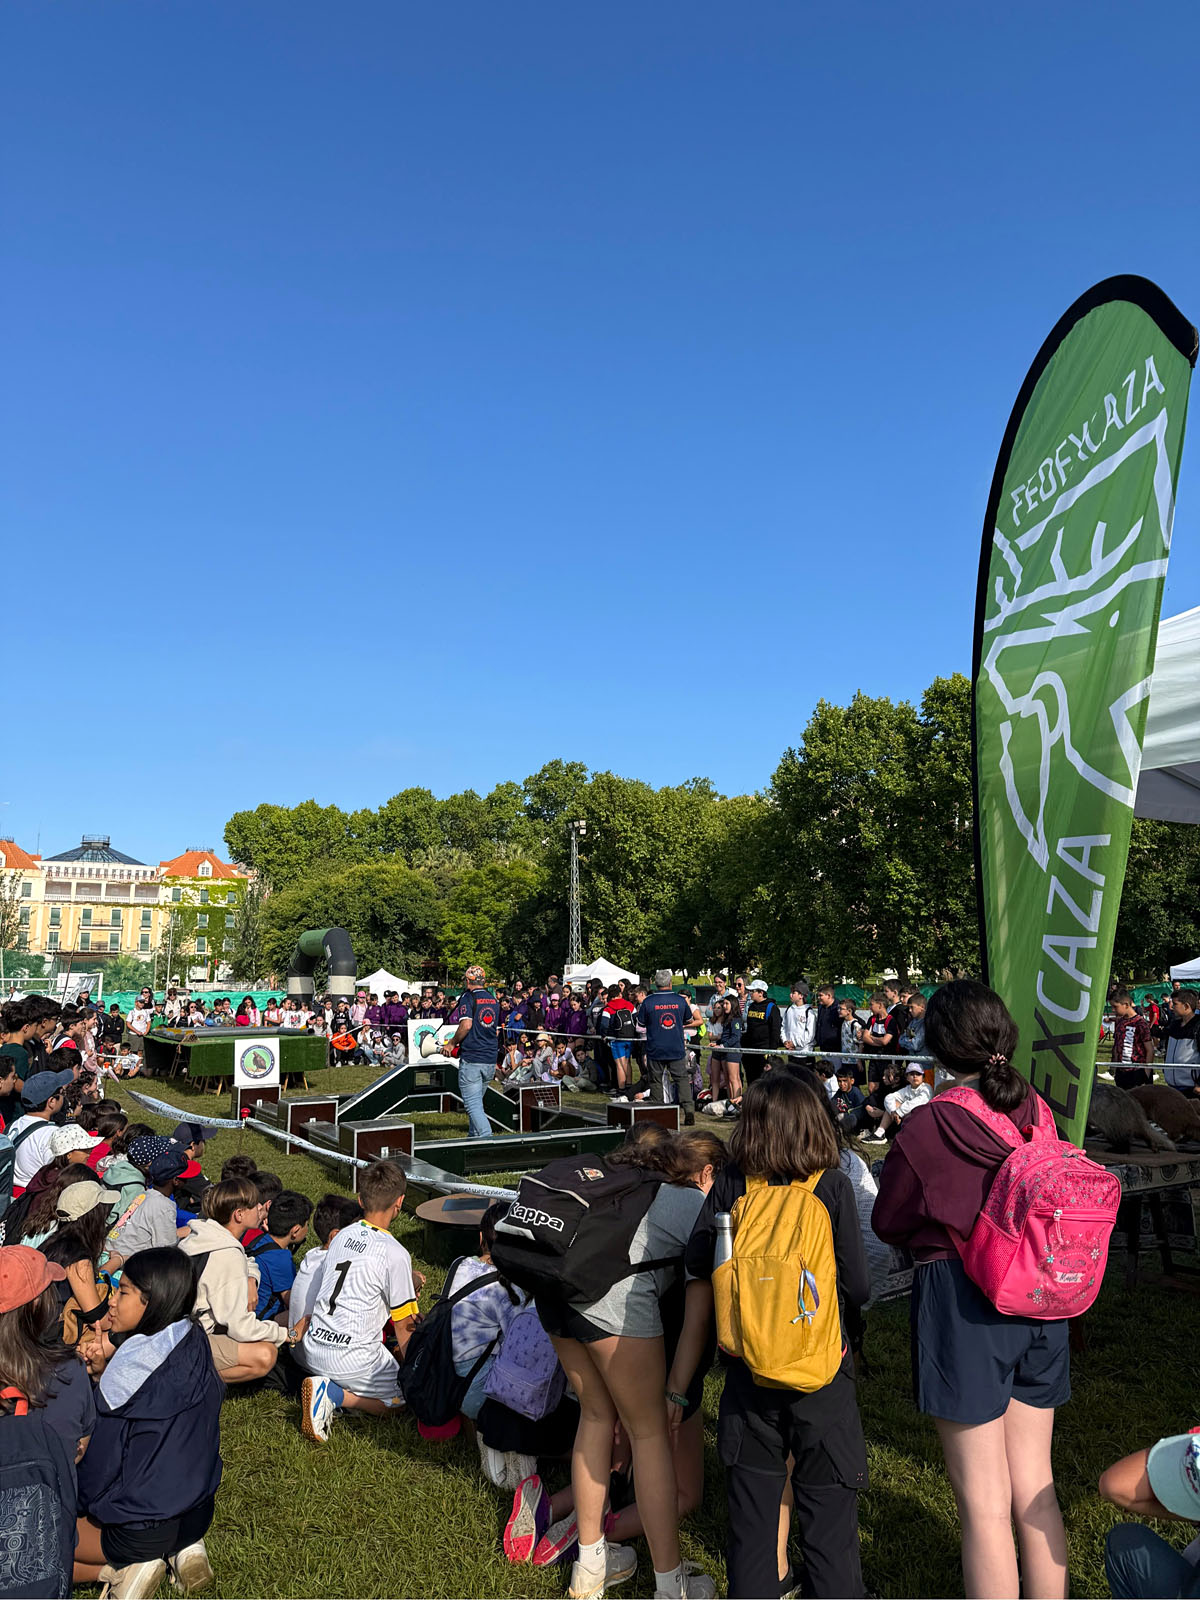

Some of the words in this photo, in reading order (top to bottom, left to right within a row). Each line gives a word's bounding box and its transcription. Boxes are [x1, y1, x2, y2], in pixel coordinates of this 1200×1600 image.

[343, 1237, 367, 1254] DARÍO
[326, 1260, 352, 1316] 1
[312, 1327, 352, 1345] STRENIA
